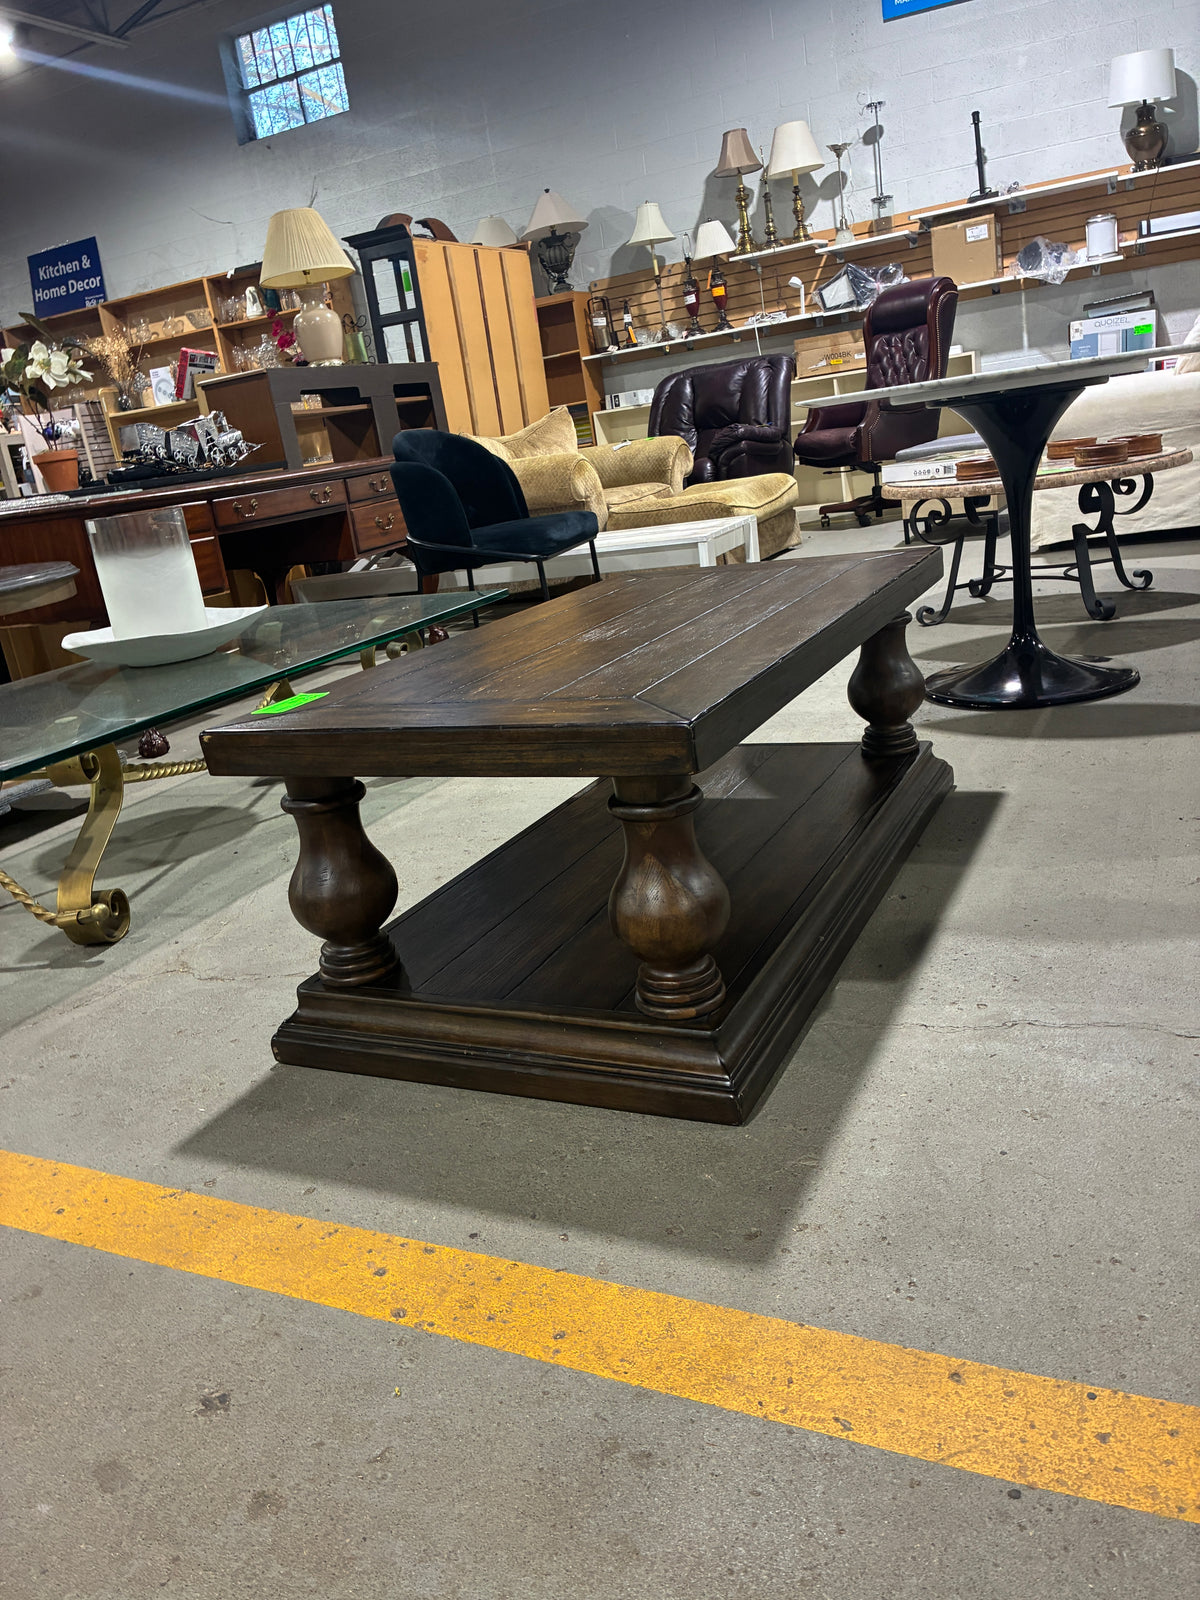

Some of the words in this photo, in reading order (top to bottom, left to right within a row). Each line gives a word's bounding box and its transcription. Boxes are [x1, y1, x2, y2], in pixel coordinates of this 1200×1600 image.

[38, 260, 80, 281] Kitchen
[81, 254, 91, 269] &
[34, 285, 67, 303] Home
[68, 275, 102, 294] Decor
[1093, 316, 1130, 328] QUOIZEL
